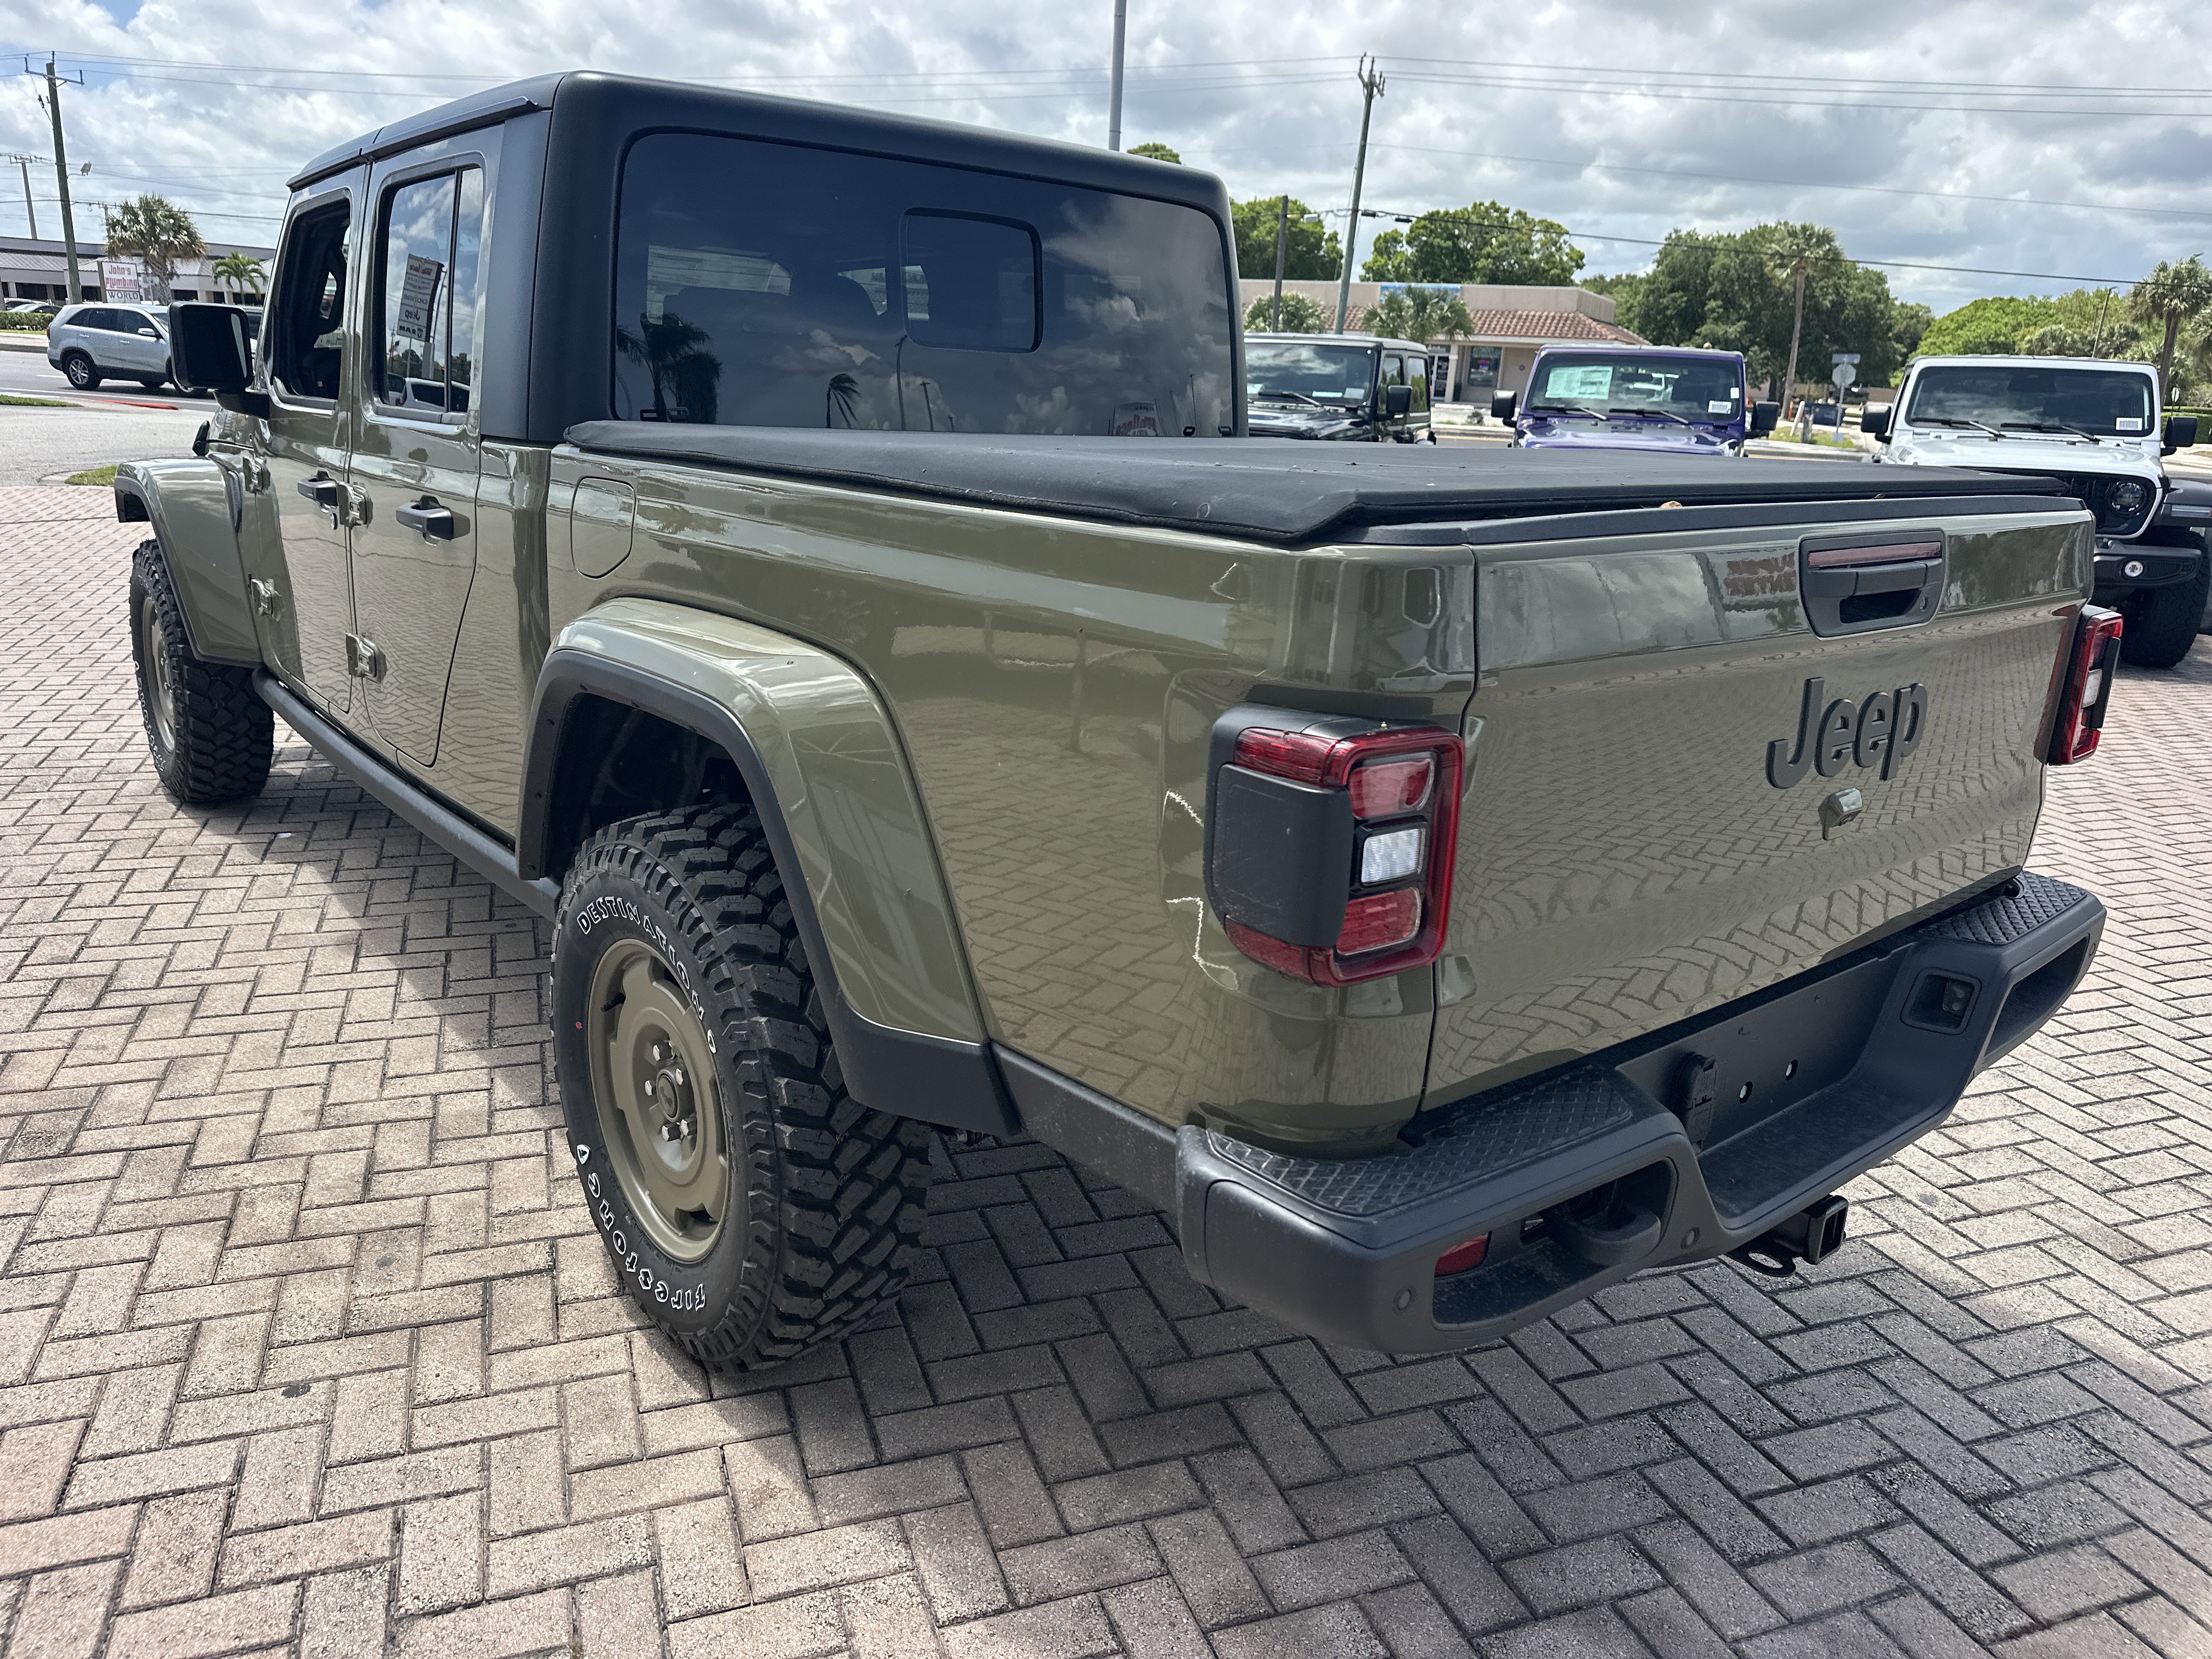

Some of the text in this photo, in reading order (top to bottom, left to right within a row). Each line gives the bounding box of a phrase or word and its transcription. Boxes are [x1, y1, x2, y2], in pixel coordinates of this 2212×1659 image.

[109, 265, 131, 275] John's
[105, 277, 138, 290] Plumbing
[108, 291, 138, 300] WORLD
[1765, 676, 1928, 789] Jeep
[577, 896, 704, 1020] DESTINATION
